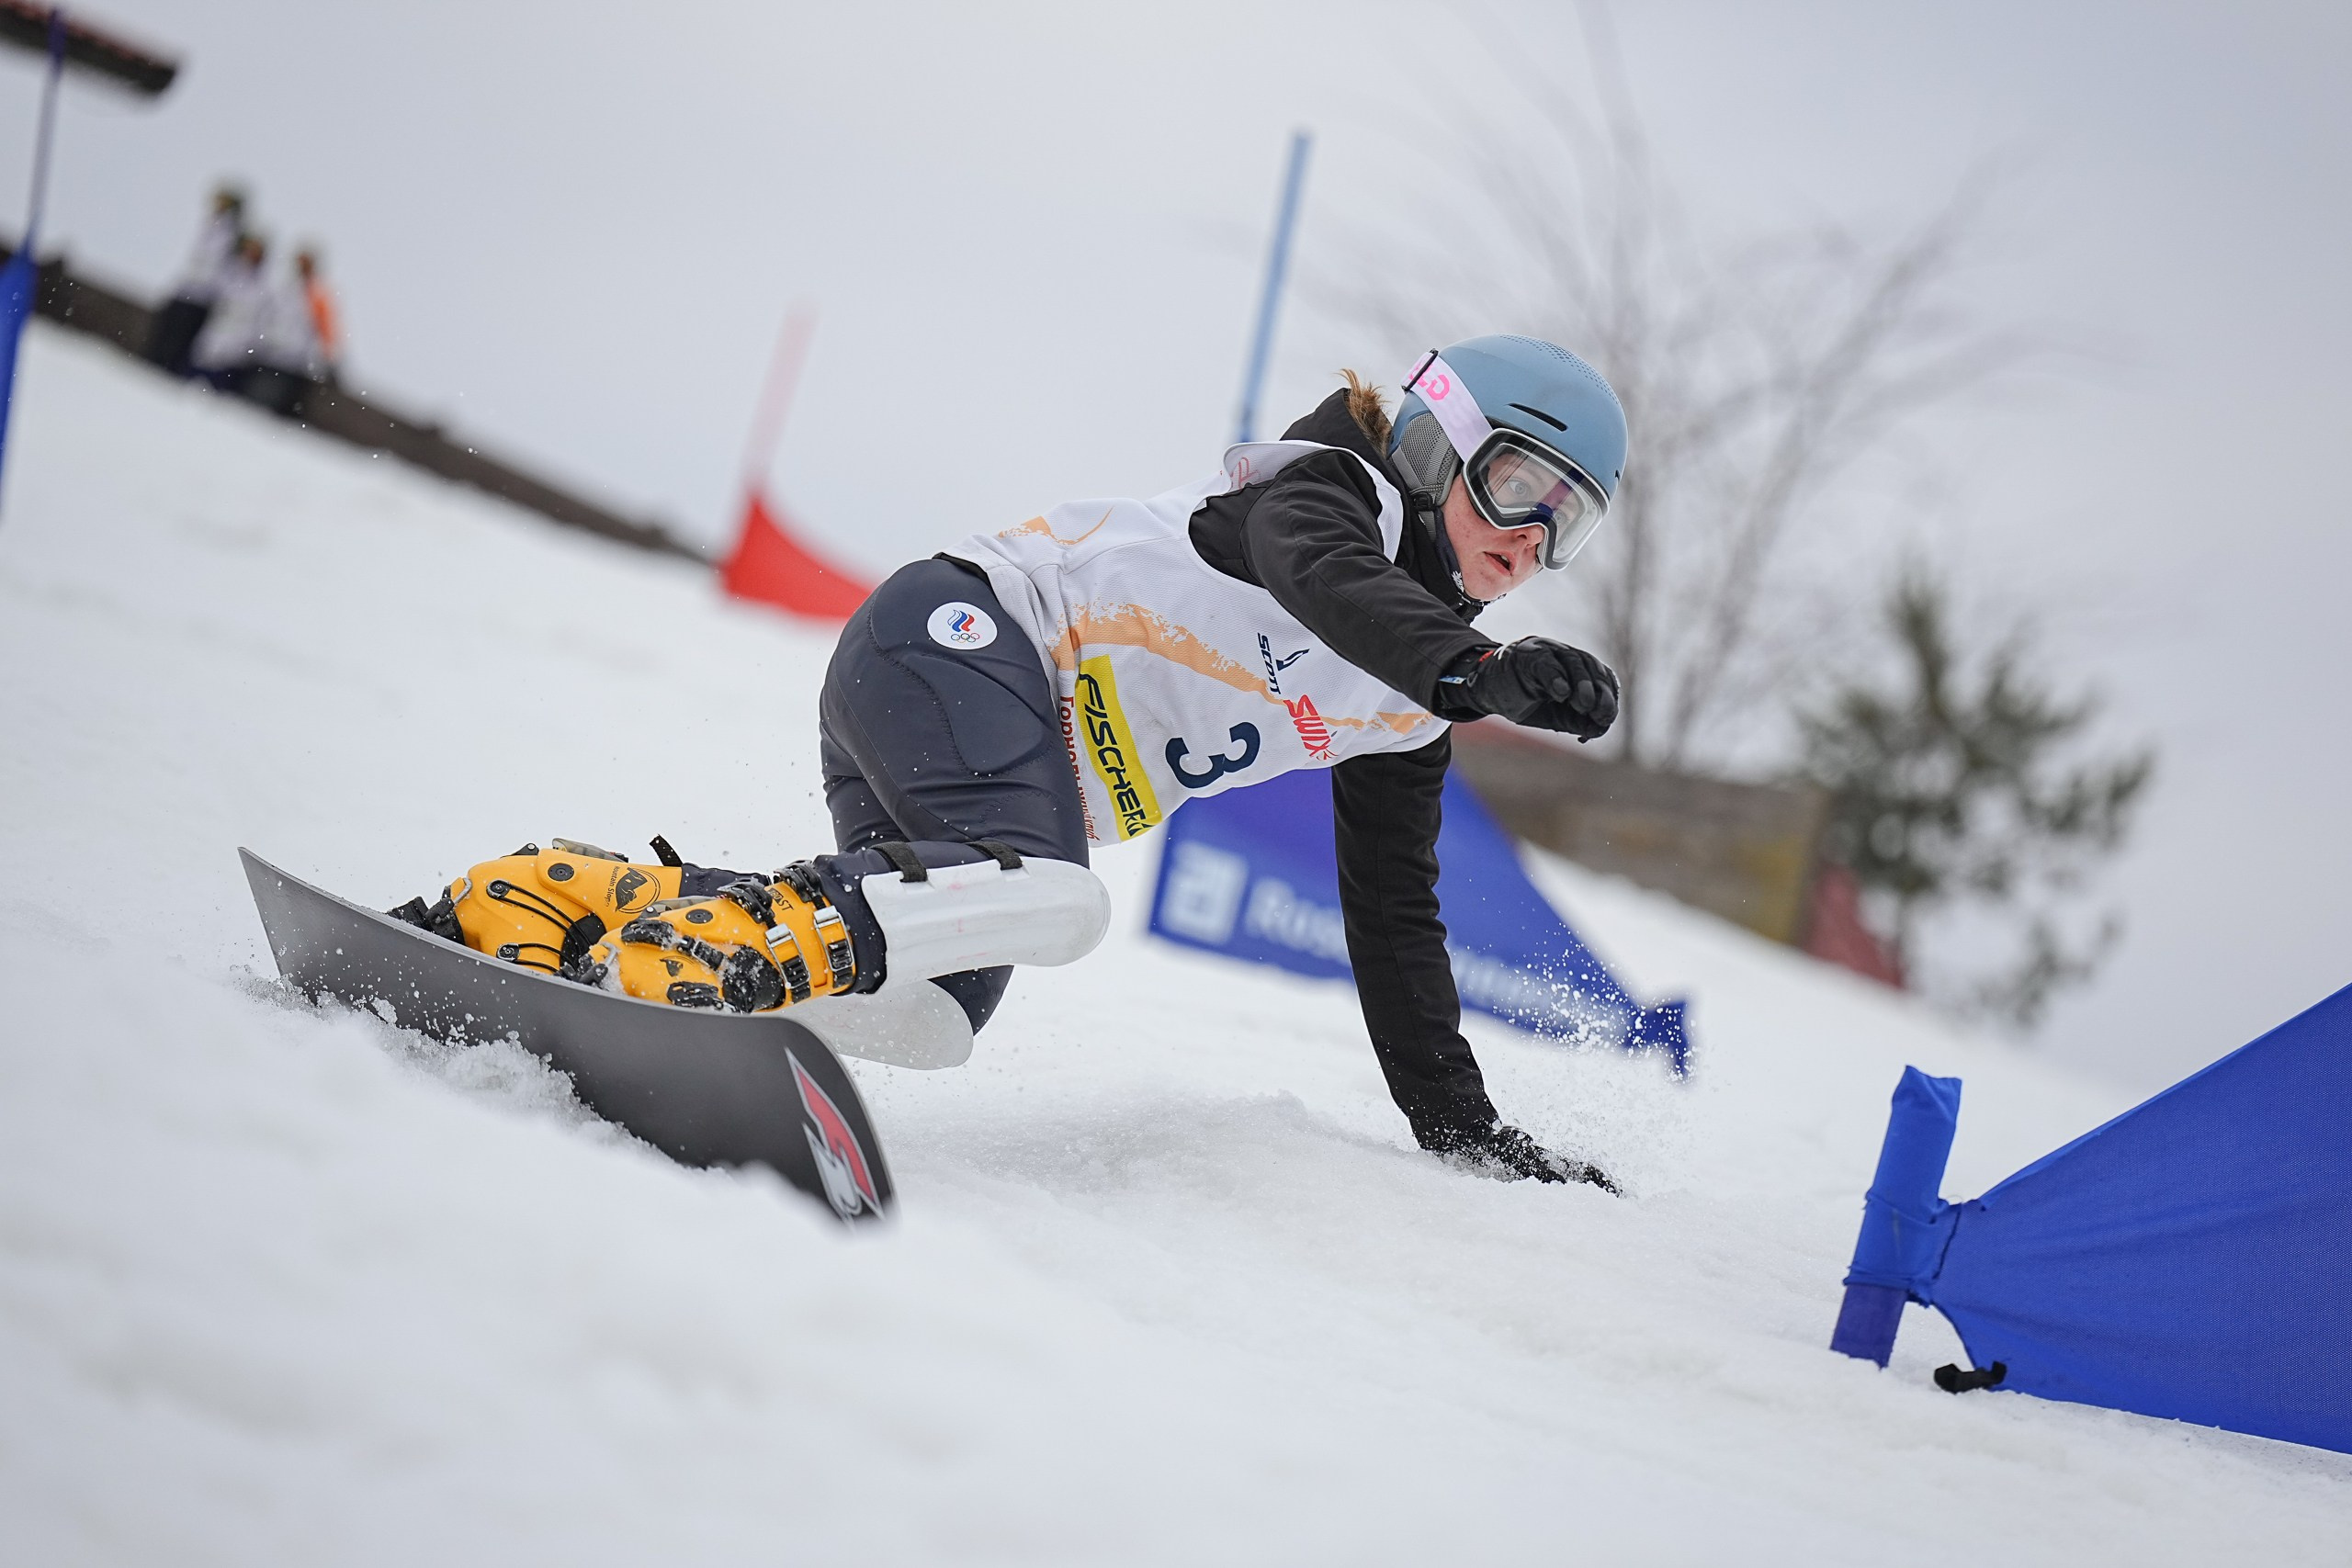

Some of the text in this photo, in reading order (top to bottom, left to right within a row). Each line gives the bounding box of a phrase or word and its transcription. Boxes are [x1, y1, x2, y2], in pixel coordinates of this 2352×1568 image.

[1257, 632, 1281, 694] SCOTT
[1079, 673, 1147, 827] FISCHER
[1165, 722, 1261, 789] 3
[1283, 694, 1331, 757] SWIX
